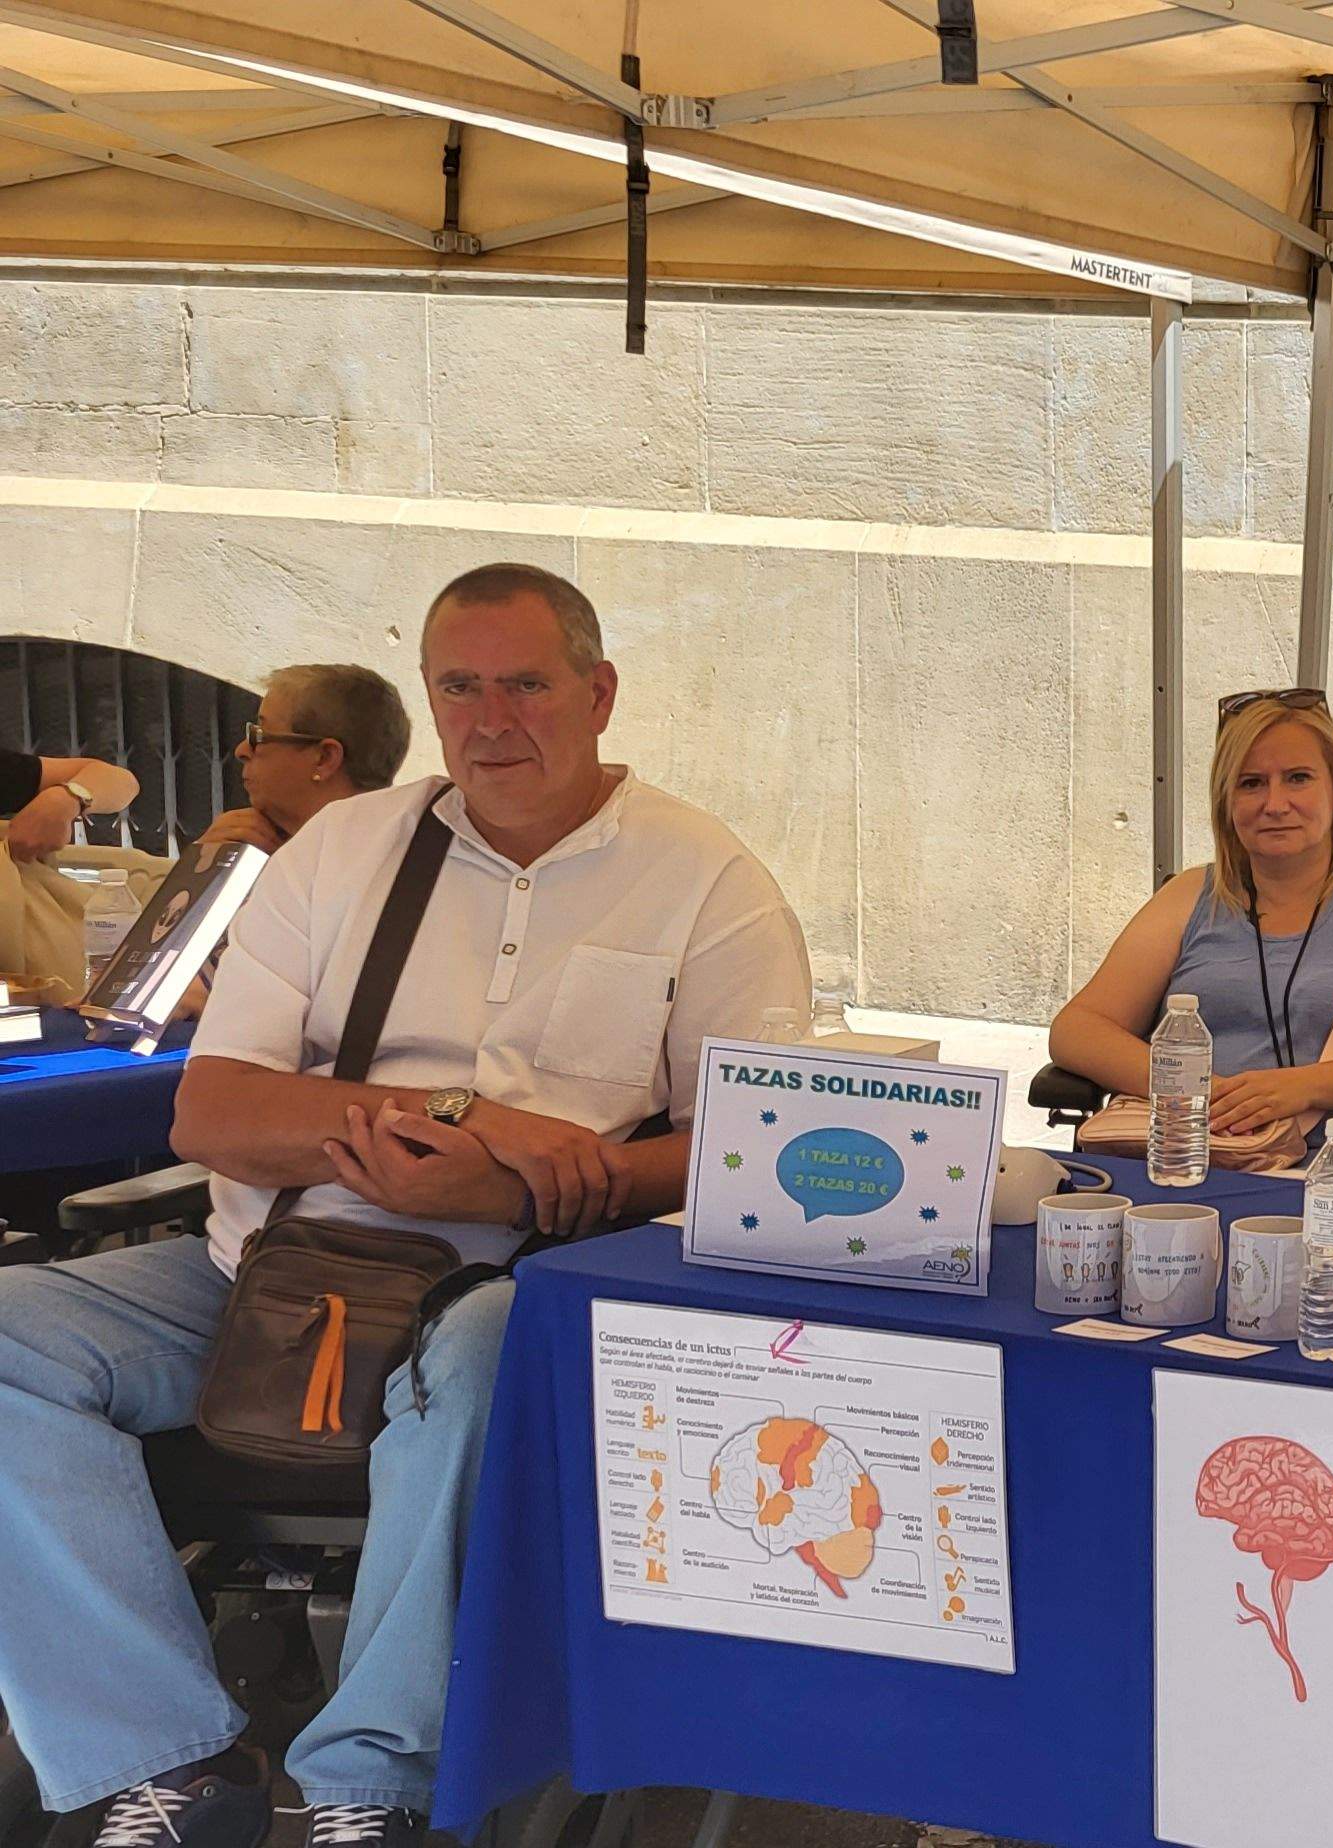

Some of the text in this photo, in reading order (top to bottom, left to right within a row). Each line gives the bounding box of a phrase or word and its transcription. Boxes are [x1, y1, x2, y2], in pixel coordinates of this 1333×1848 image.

[1071, 255, 1152, 289] MASTERTENT
[718, 1063, 981, 1111] TAZAS SOLIDARIAS!!
[811, 1150, 849, 1165] TAZA
[794, 1173, 804, 1186] 2
[808, 1176, 855, 1192] TAZAS
[859, 1182, 876, 1194] 20
[922, 1259, 965, 1273] AENO
[599, 1331, 673, 1351] Consecuencias
[674, 1341, 688, 1351] de
[690, 1343, 704, 1353] un
[812, 1369, 834, 1383] partes
[836, 1370, 847, 1382] del
[848, 1373, 872, 1387] cuerpo
[846, 1405, 920, 1422] Movimientos básicos
[676, 1418, 724, 1431] Conocimiento
[941, 1417, 989, 1431] HEMISFERIO
[880, 1426, 920, 1439] Percepción
[946, 1428, 985, 1442] DERECHO
[637, 1448, 667, 1462] texto
[863, 1448, 921, 1463] Reconocimiento
[899, 1463, 921, 1473] visual
[897, 1512, 922, 1523] Centro
[955, 1513, 981, 1523] Control
[901, 1532, 924, 1542] visión
[879, 1577, 927, 1591] Coordinación
